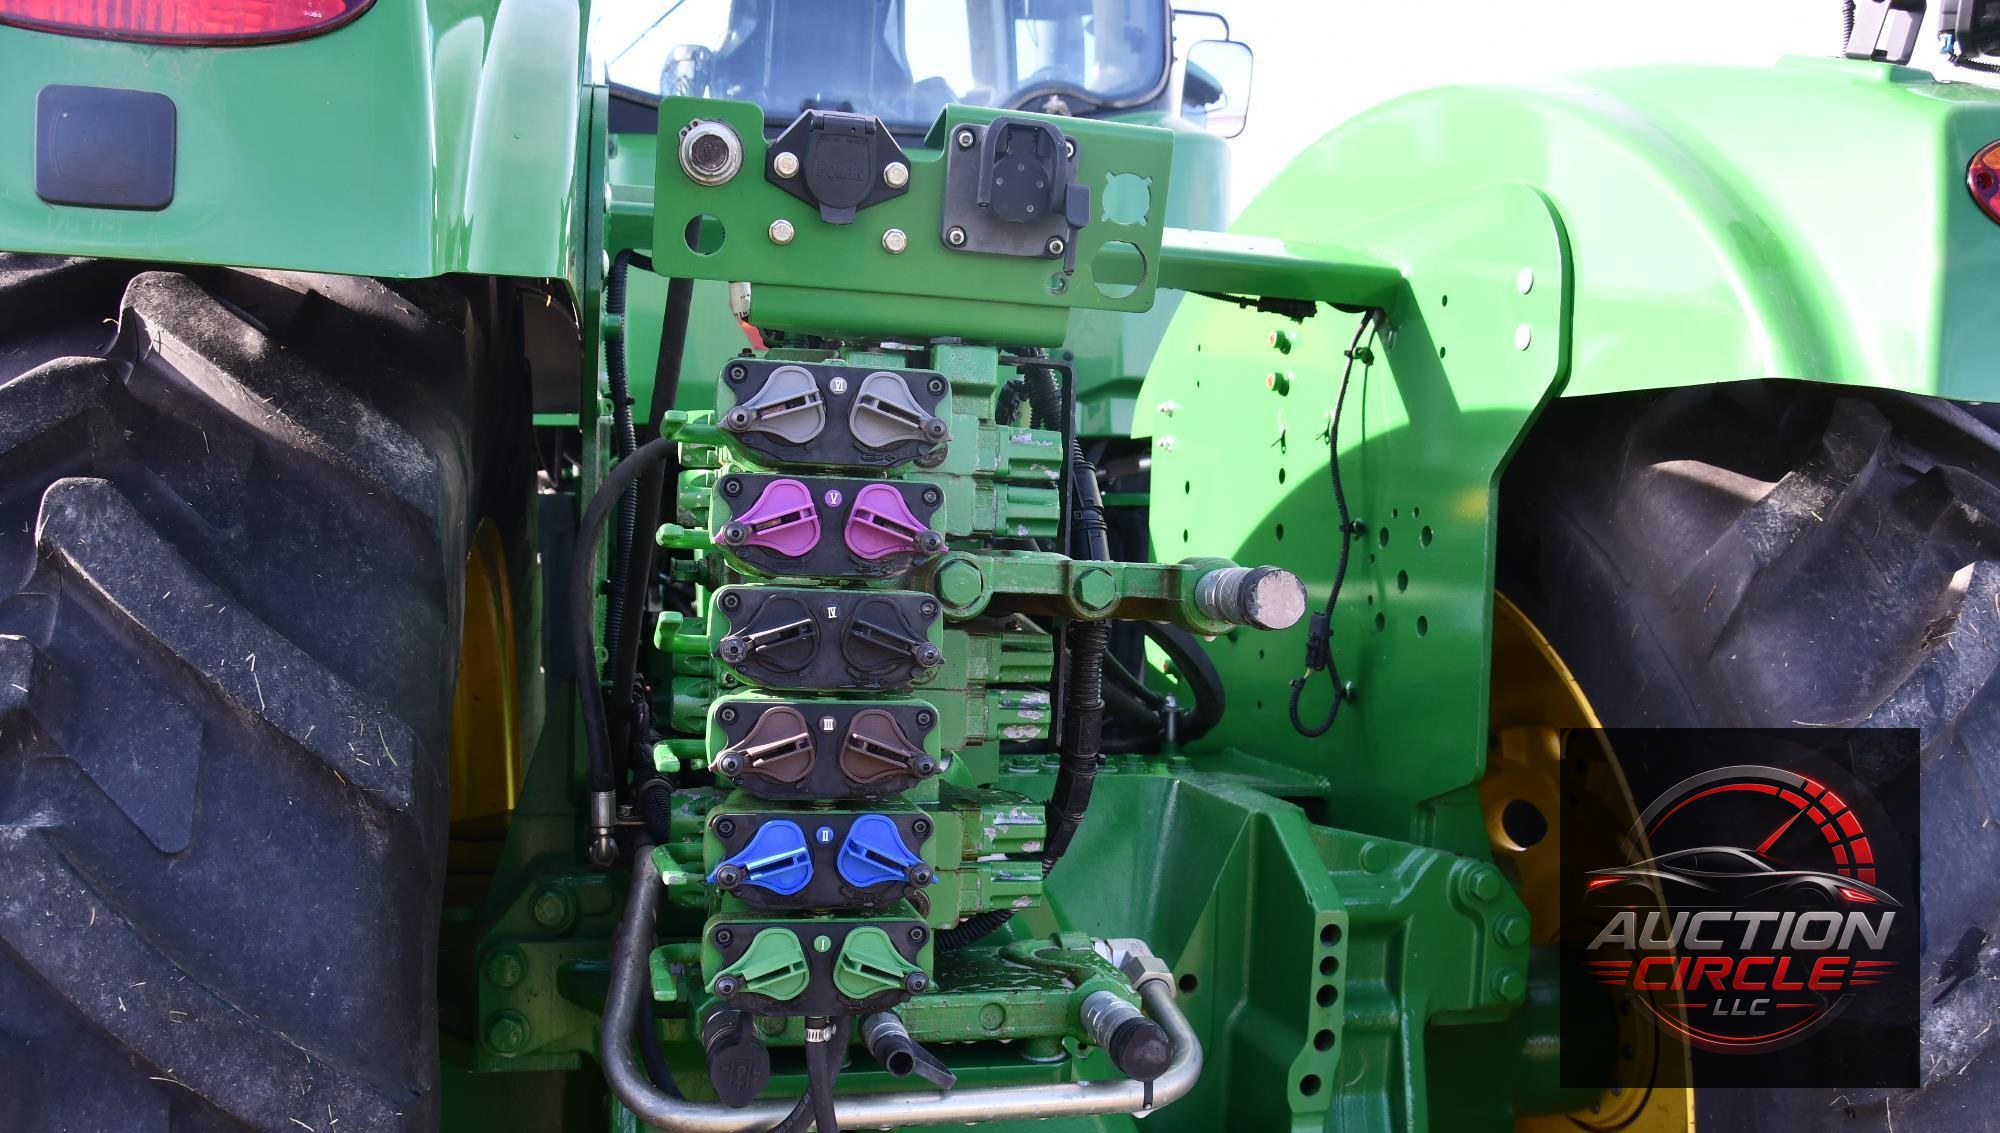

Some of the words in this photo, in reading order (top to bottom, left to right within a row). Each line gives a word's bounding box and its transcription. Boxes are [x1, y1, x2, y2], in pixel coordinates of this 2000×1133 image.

[834, 380, 844, 391] VI
[830, 492, 839, 505] V
[827, 606, 837, 619] IV
[823, 718, 834, 731] III
[821, 830, 829, 842] II
